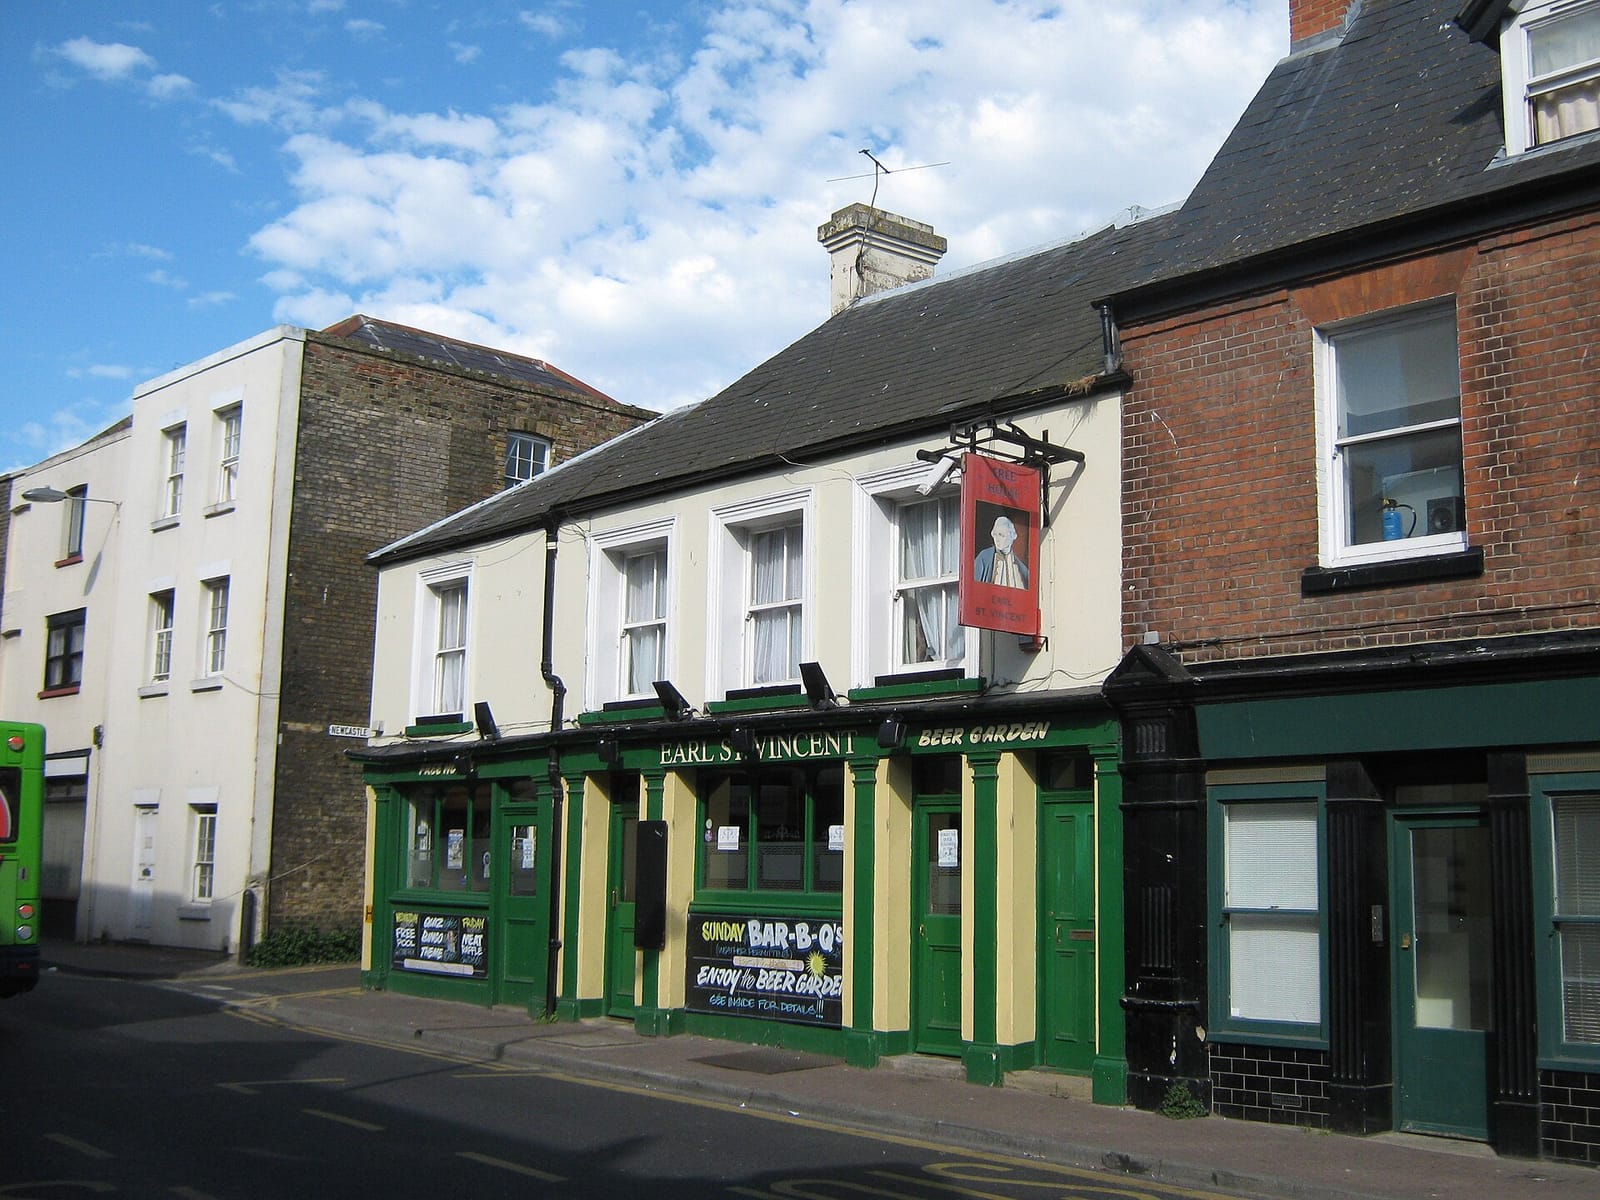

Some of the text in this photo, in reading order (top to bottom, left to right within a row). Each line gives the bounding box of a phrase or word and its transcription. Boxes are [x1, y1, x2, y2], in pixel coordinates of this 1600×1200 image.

[331, 726, 368, 737] NEWCASTLE
[918, 721, 1050, 747] BEER GARDEN
[660, 741, 714, 765] EARL
[754, 730, 857, 760] VINCENT
[424, 917, 444, 929] QUIZ
[462, 918, 484, 929] FRIDAY
[396, 928, 416, 939] FREE
[421, 930, 444, 944] BINGO
[702, 921, 745, 942] SUNDAY
[396, 938, 416, 947] POOL
[462, 933, 484, 947] MEAT
[420, 946, 444, 960] THEME
[697, 966, 741, 995] ENJOY
[756, 968, 796, 993] BEER
[709, 994, 727, 1006] SEE
[727, 998, 755, 1008] INSIDE
[758, 1000, 779, 1010] FOR
